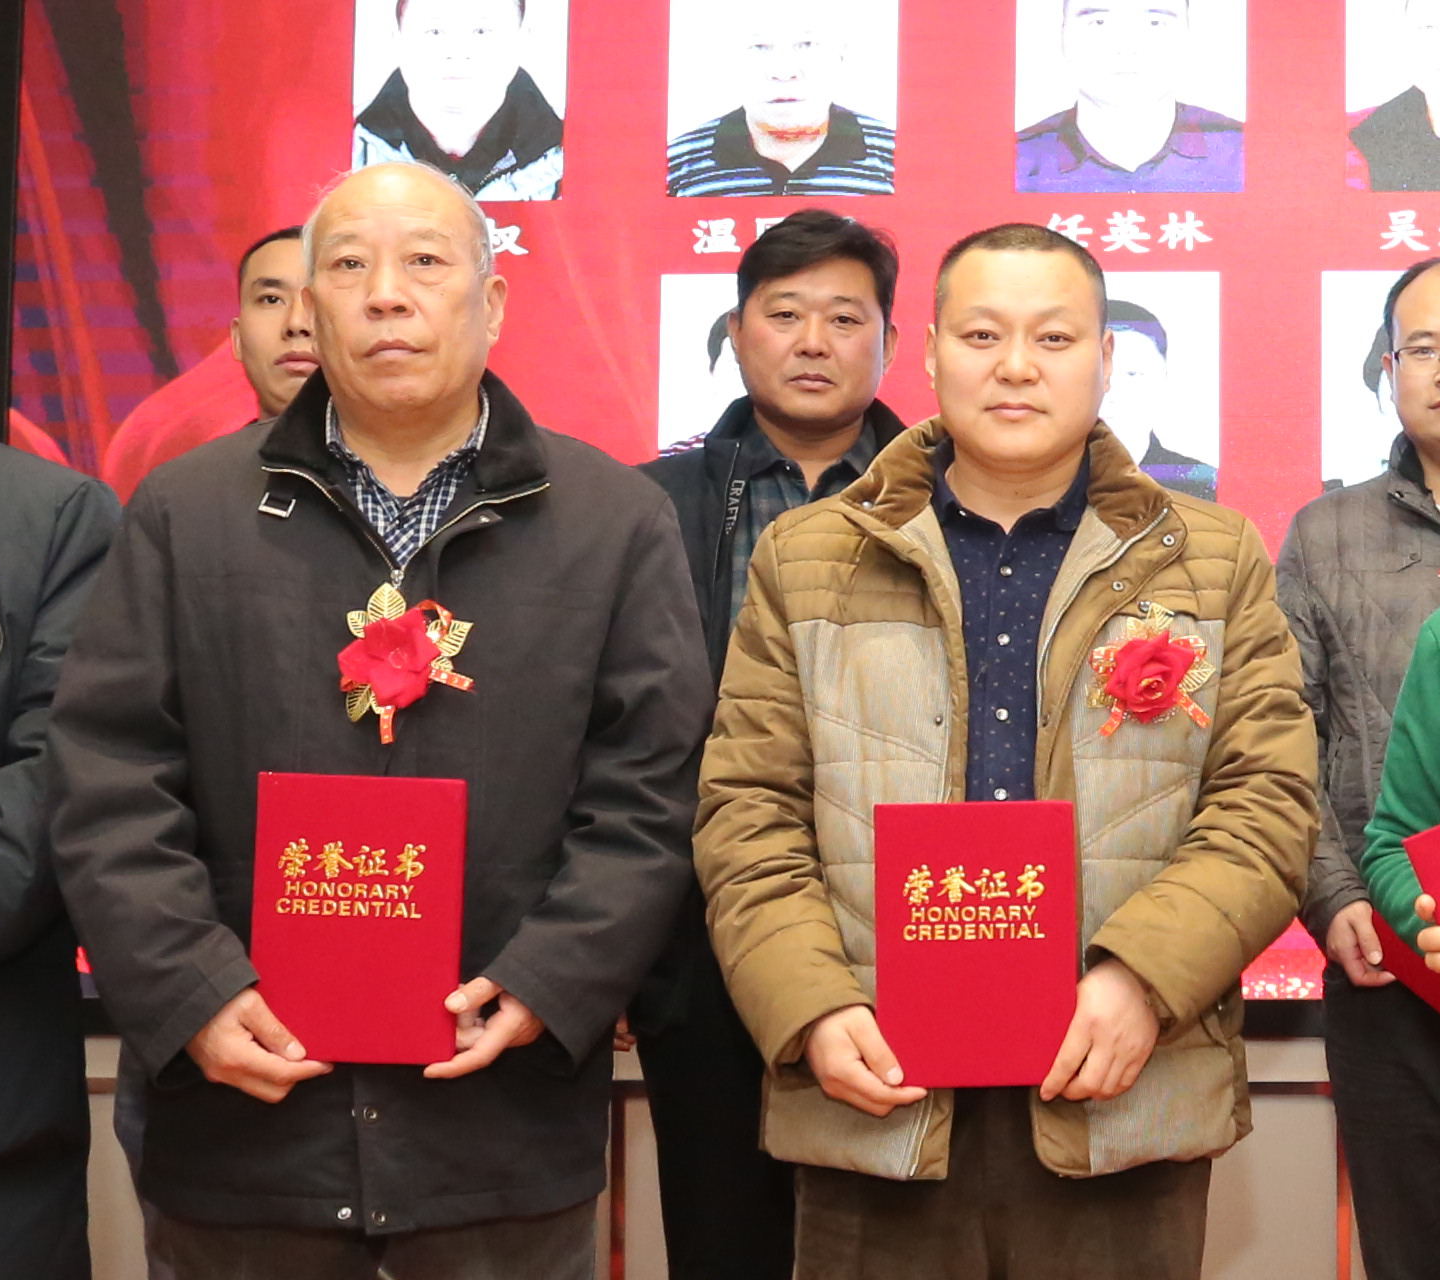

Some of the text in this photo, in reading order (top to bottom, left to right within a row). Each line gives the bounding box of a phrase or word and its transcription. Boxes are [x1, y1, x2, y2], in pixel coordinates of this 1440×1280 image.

[277, 838, 427, 881] 荣誉证书
[285, 880, 415, 900] HONORARY
[902, 864, 1046, 905] 荣誉证书
[276, 898, 422, 919] CREDENTIAL
[911, 905, 1037, 923] HONORARY
[903, 923, 1046, 941] CREDENTIAL
